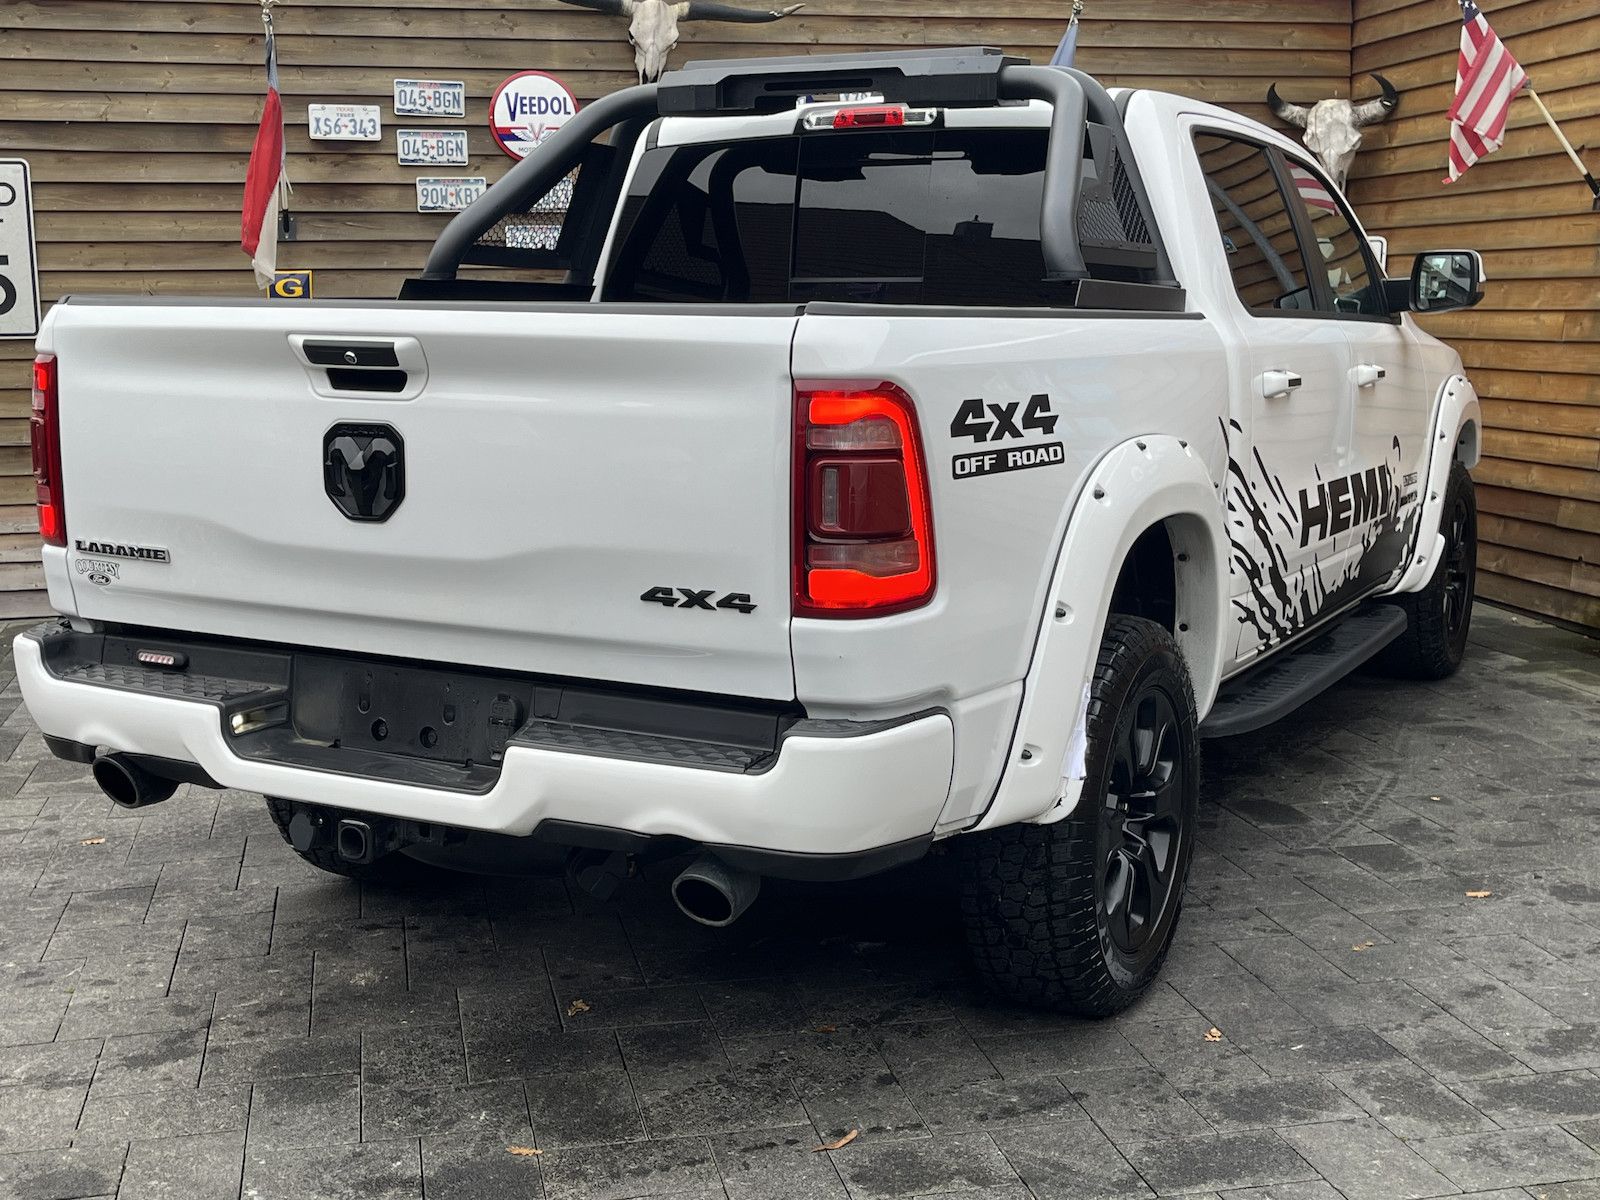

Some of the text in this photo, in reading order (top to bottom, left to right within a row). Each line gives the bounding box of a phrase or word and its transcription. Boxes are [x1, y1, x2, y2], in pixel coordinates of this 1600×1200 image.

[399, 89, 461, 109] 045 BGN
[505, 92, 571, 121] VEEDOL
[349, 119, 377, 135] 343
[402, 139, 464, 157] 045 BGN
[275, 277, 304, 298] G
[954, 446, 1063, 476] OFF ROAD
[1298, 464, 1390, 549] HEMI
[75, 539, 166, 560] LARAMIE
[75, 559, 120, 579] COURTESY
